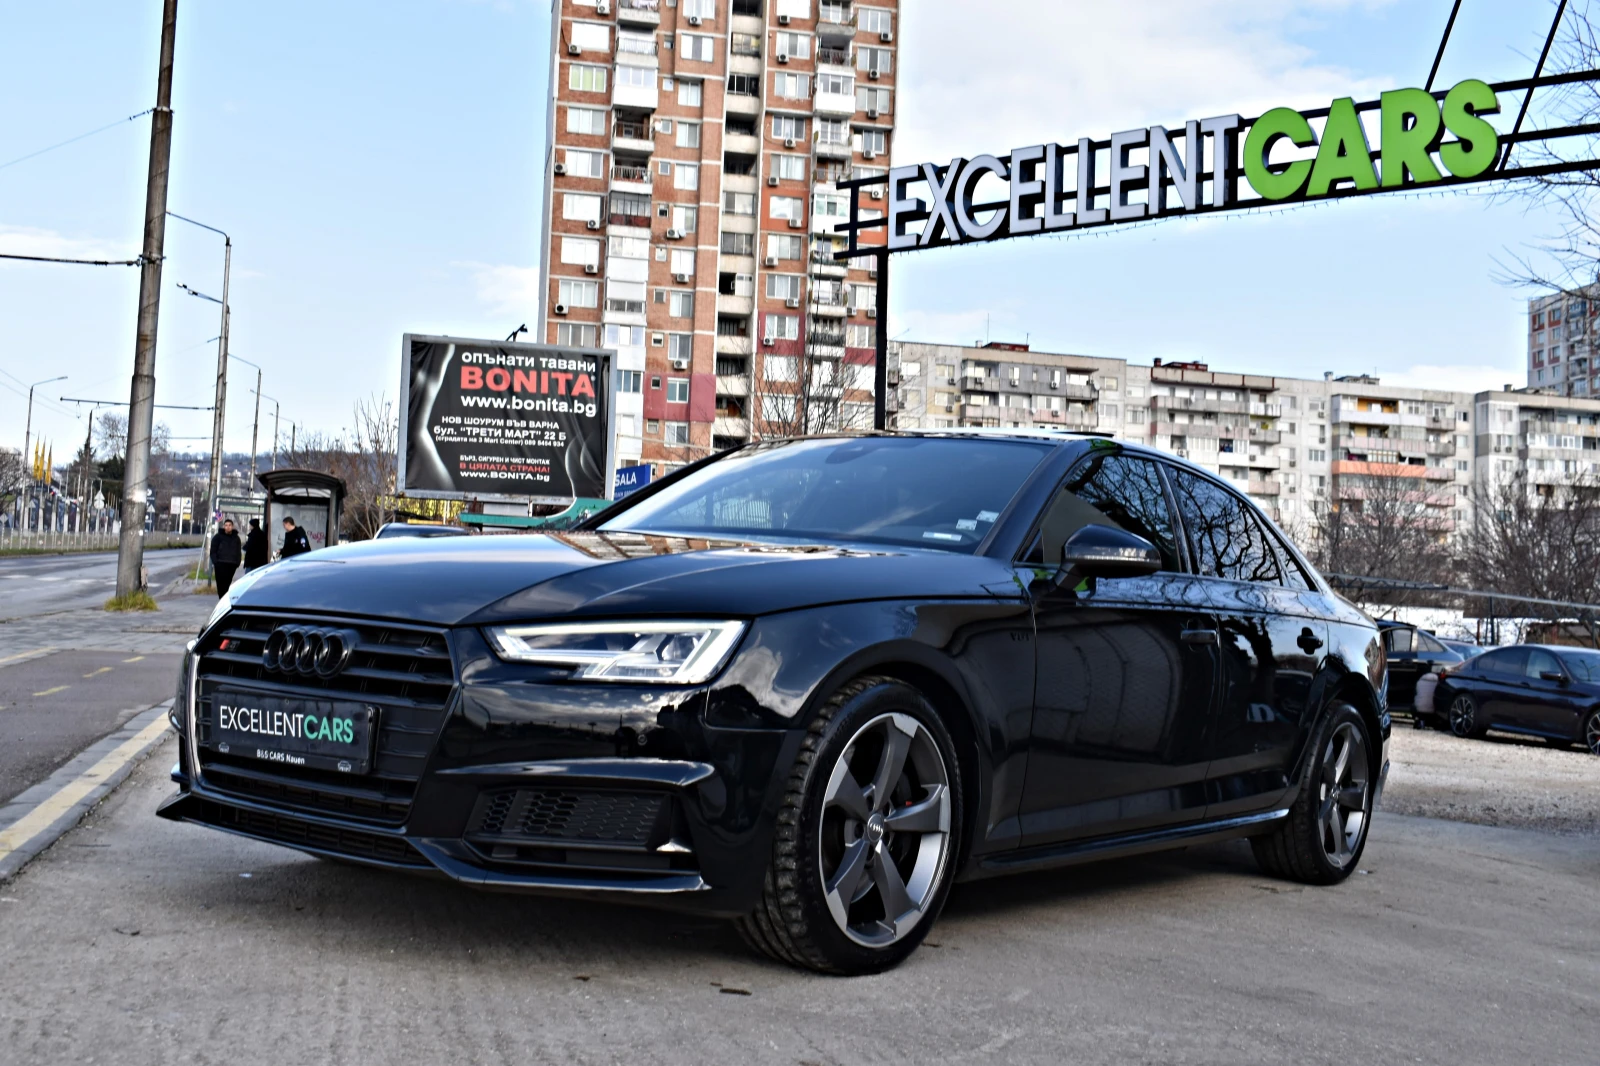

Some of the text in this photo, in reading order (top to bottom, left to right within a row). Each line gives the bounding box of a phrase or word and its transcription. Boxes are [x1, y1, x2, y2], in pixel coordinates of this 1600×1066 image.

[461, 352, 596, 372] опънати тавани
[460, 365, 596, 398] BONITA
[460, 396, 597, 418] www.bonita.bg
[441, 416, 560, 430] НОВ ШОУРУМ ВЪВ ВАРНА
[433, 425, 457, 436] бул.
[544, 431, 556, 440] 22
[559, 432, 567, 441] Б
[478, 455, 504, 463] СИГУРЕН
[469, 463, 507, 471] ЦЯЛАТА
[510, 464, 550, 473] СТРАНА!
[459, 471, 550, 482] www.BONITA.bg
[269, 751, 285, 762] CARS
